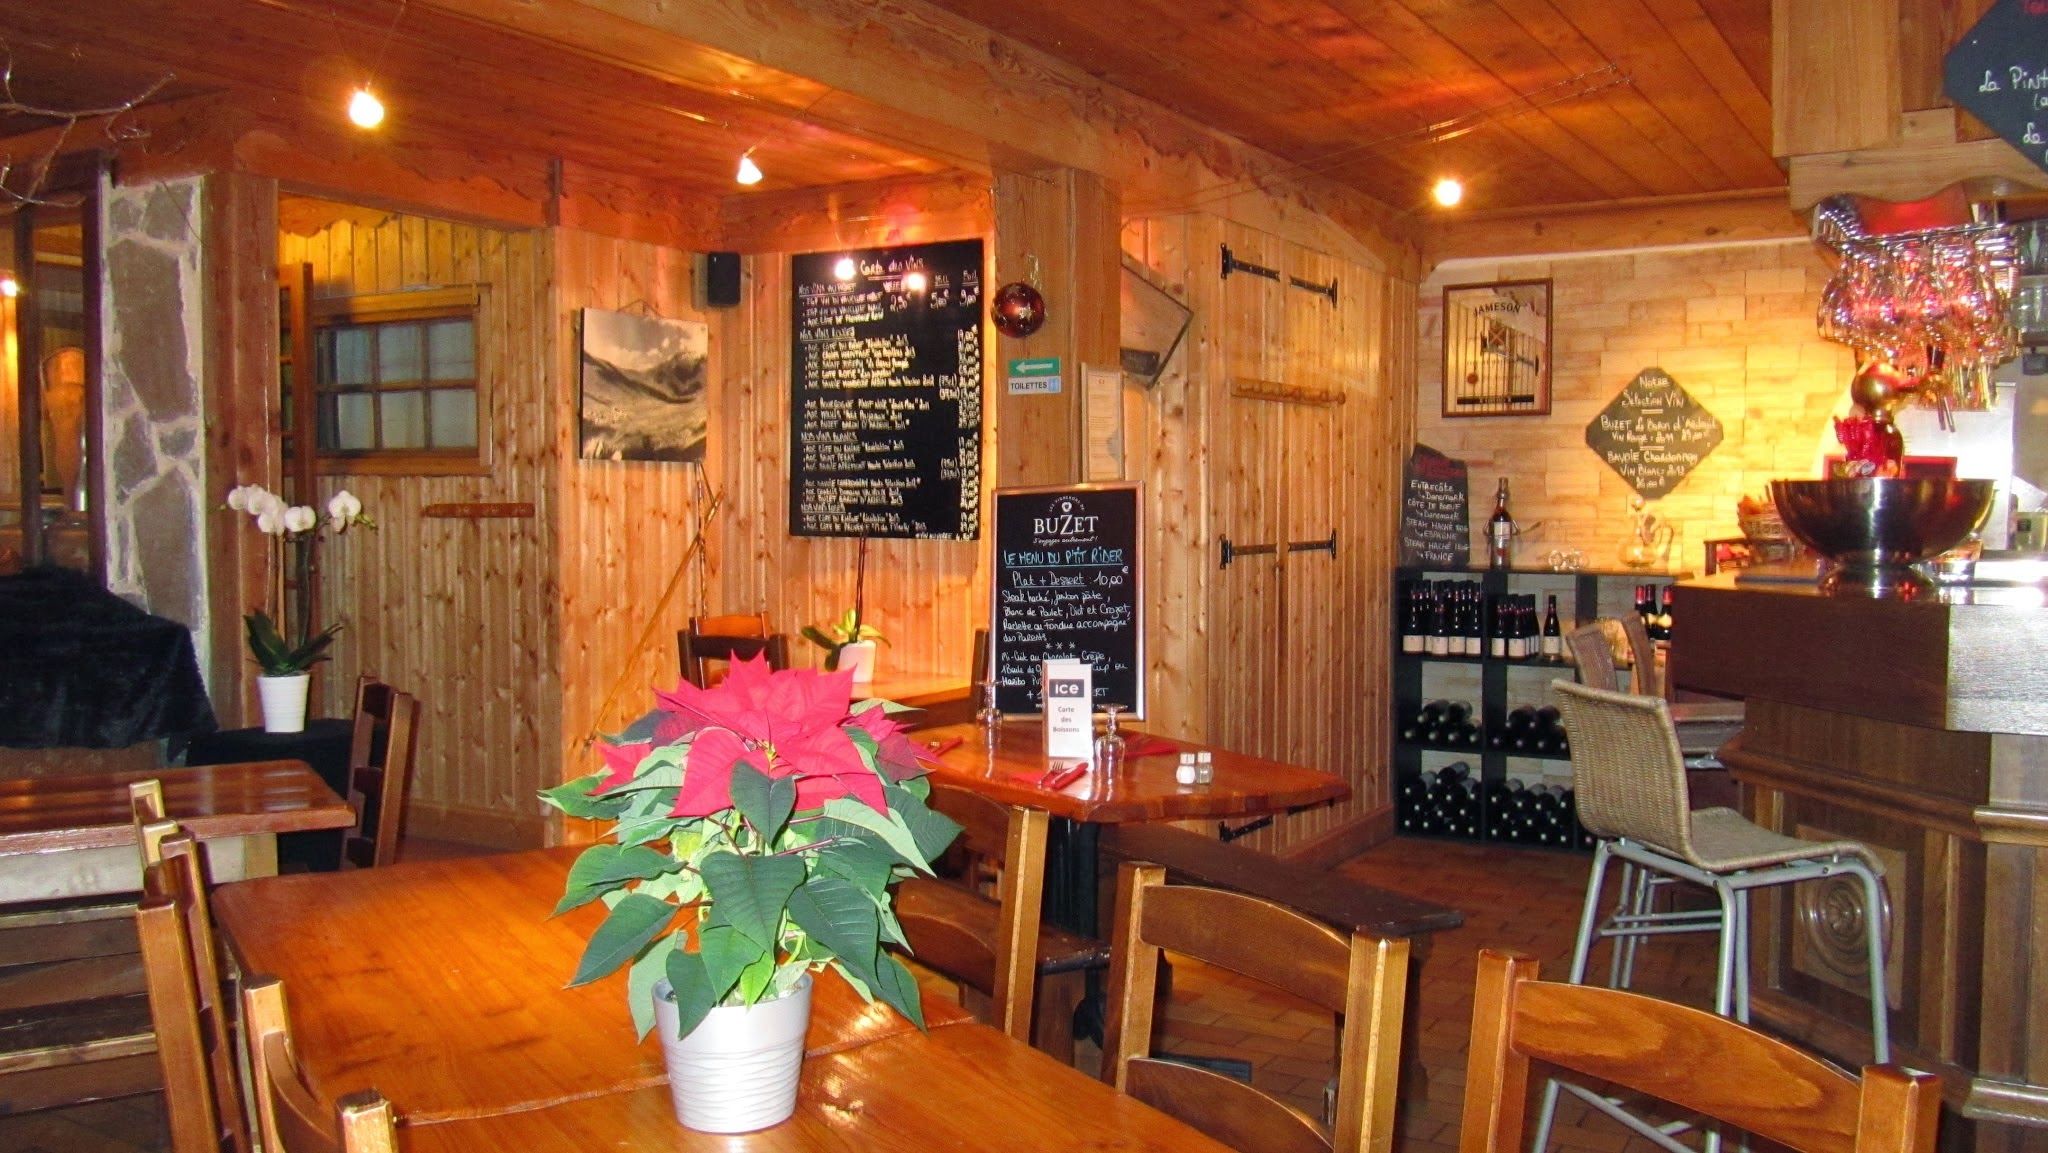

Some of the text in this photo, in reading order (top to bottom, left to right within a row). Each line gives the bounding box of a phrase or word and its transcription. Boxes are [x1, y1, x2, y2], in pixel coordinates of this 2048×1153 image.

[1473, 301, 1521, 317] JAMESON
[1011, 382, 1048, 390] TOILETTES
[1600, 414, 1632, 431] BUZET
[1033, 514, 1099, 535] BUZET
[1003, 549, 1017, 566] LE
[1018, 551, 1044, 565] MENU
[1047, 551, 1060, 564] DU
[1423, 550, 1455, 562] FRANCE
[1012, 570, 1037, 587] Plat
[1026, 607, 1037, 617] de
[1086, 604, 1098, 615] et
[1029, 653, 1041, 661] au
